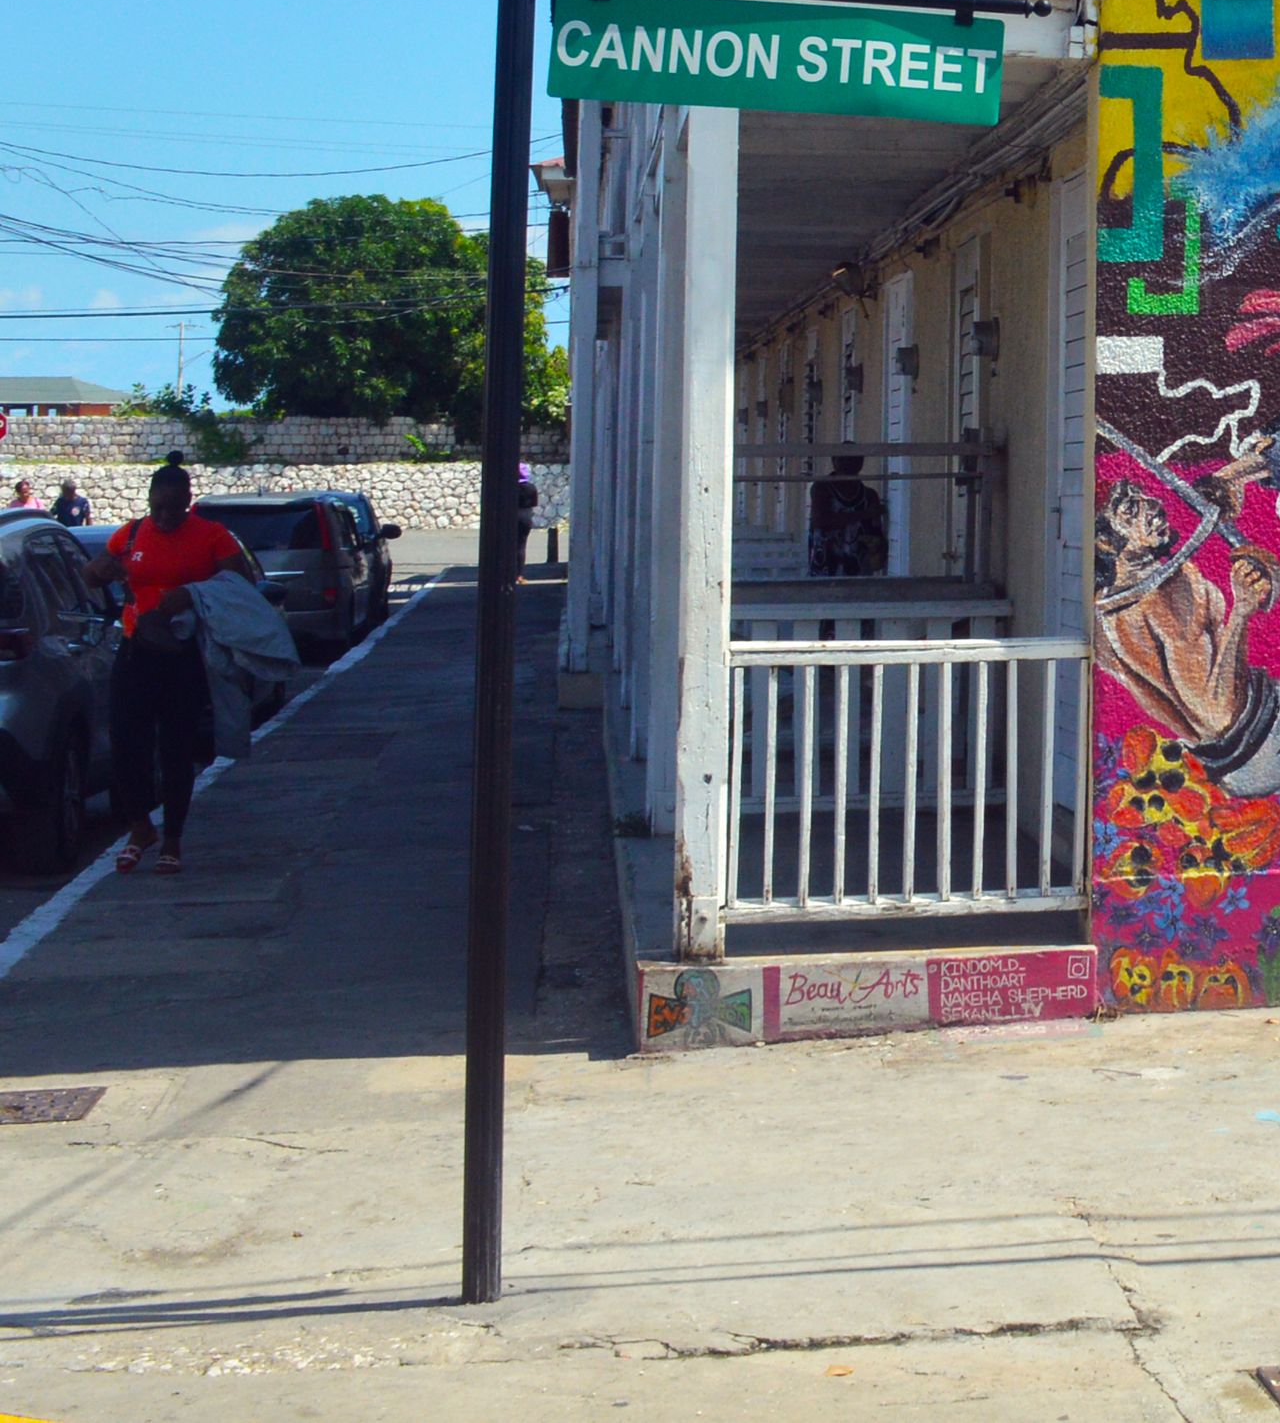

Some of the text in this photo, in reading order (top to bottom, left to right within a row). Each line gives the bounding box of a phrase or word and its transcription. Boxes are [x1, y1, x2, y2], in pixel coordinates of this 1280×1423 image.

[556, 20, 998, 95] CANNON STREET
[1008, 985, 1088, 1004] SHEPHERD
